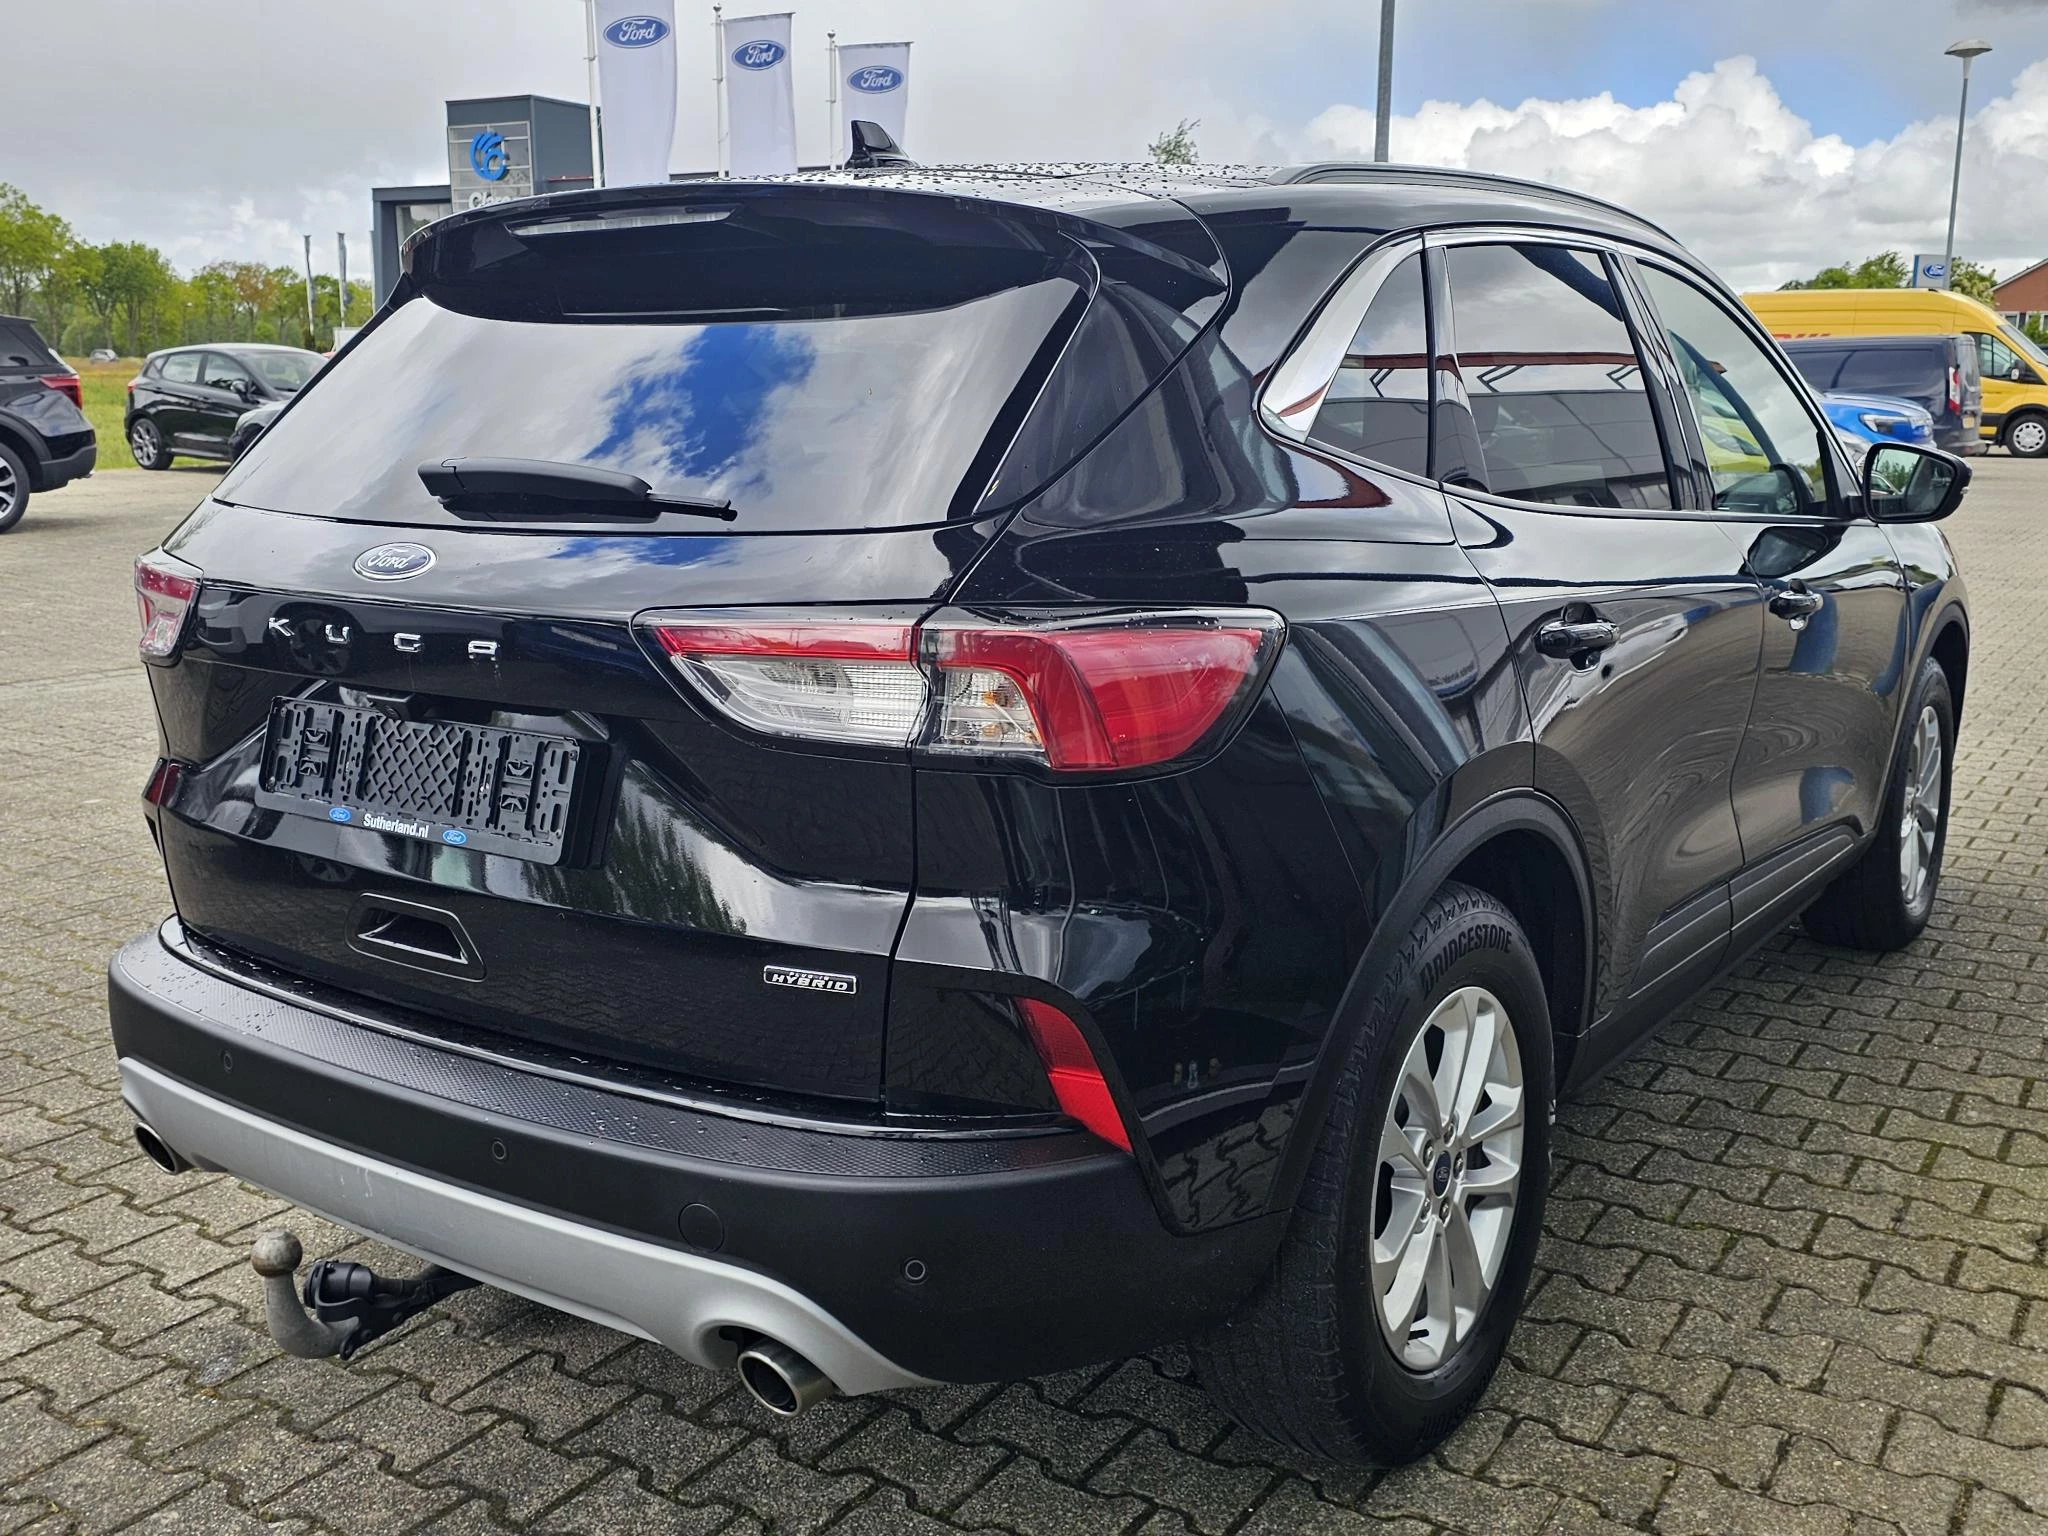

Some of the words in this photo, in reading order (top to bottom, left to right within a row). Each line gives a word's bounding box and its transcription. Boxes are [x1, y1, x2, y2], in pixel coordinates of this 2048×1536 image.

[268, 617, 499, 661] KUGA
[362, 813, 430, 839] Sutherland.nl
[1420, 924, 1513, 999] BRIDGESTONE
[771, 973, 848, 991] HYBRID
